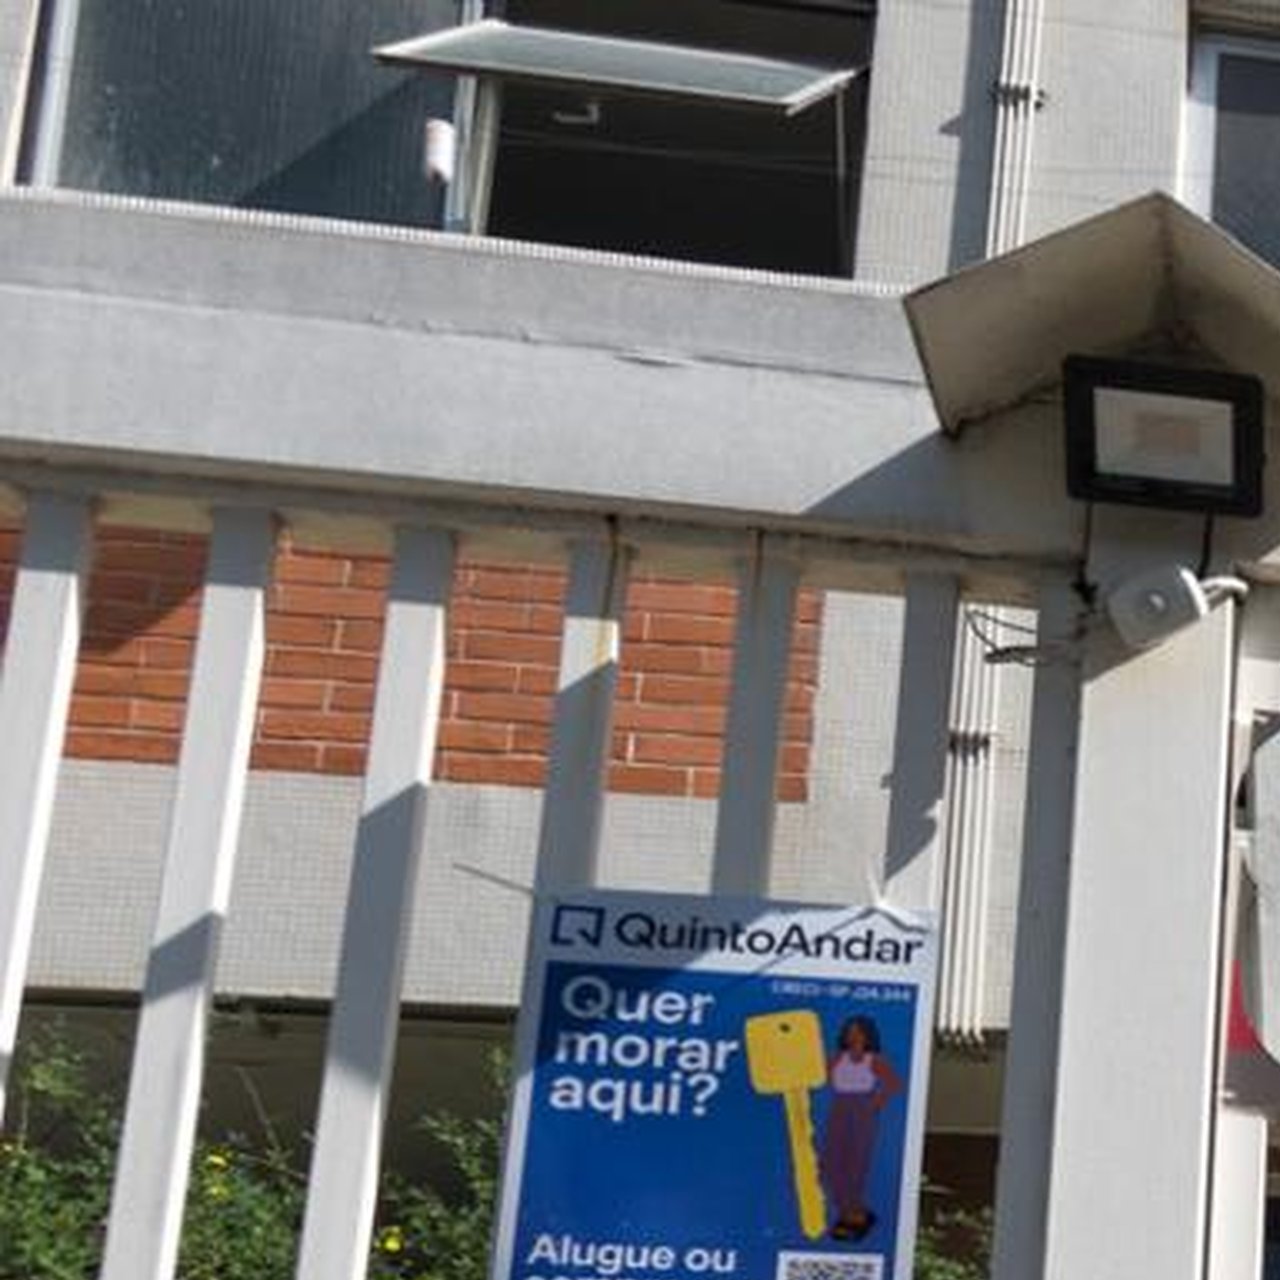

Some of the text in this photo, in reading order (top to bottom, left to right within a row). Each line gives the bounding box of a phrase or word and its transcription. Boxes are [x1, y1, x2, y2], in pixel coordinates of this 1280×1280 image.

[614, 911, 924, 965] QuintoAndar
[561, 975, 717, 1025] Quer
[554, 1031, 739, 1073] morar
[549, 1072, 719, 1122] aqui?
[527, 1233, 737, 1275] Alugue ou
